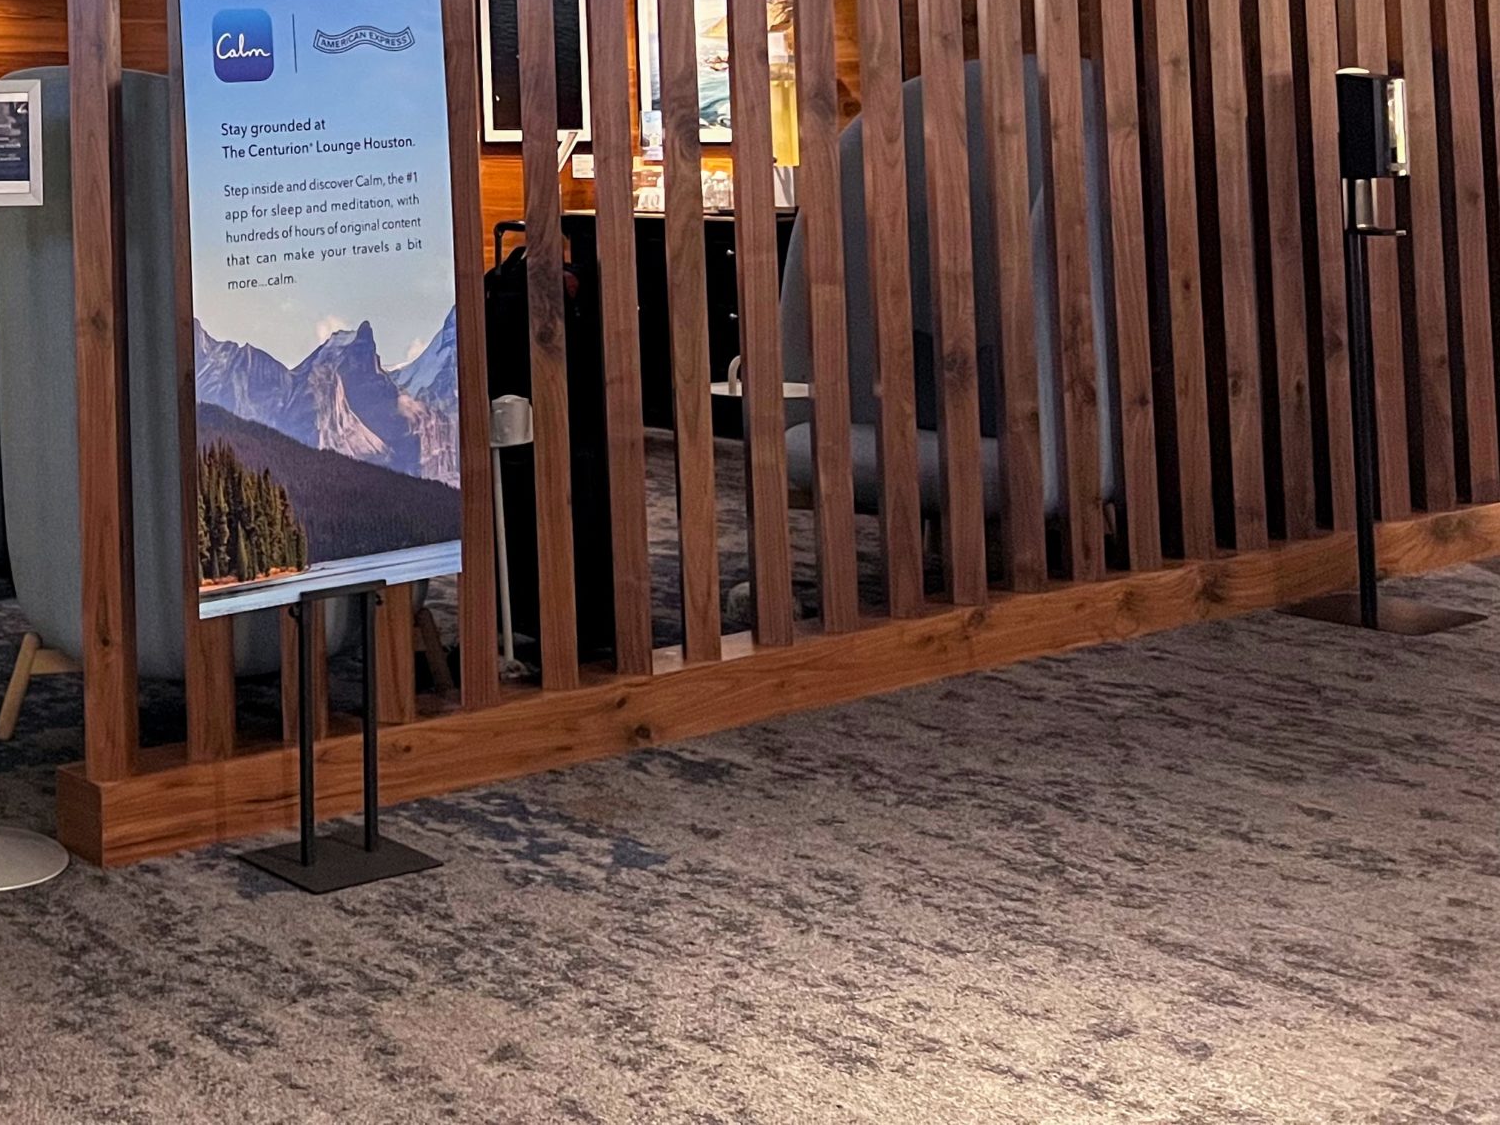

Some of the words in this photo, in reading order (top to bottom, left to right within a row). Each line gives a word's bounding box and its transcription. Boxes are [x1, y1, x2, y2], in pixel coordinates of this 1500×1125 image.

[216, 33, 270, 60] Calm
[320, 31, 367, 48] AMERICAN
[369, 32, 408, 48] EXPRESS
[222, 123, 247, 138] Stay
[251, 118, 311, 137] grounded
[314, 120, 325, 130] at
[222, 146, 245, 159] The
[316, 140, 361, 154] Lounge
[364, 137, 416, 149] Houston.
[224, 184, 249, 199] Step
[252, 182, 284, 195] inside
[286, 180, 306, 192] and
[309, 178, 353, 190] discover
[356, 175, 385, 187] Calm,
[388, 173, 403, 184] the
[407, 172, 417, 183] #1
[225, 209, 248, 222] app
[252, 206, 267, 218] for
[272, 204, 302, 217] sleep
[306, 201, 327, 213] and
[331, 198, 393, 211] meditation,
[397, 194, 419, 205] with
[226, 229, 279, 243] hundreds
[282, 226, 293, 238] of
[295, 226, 325, 237] hours
[328, 222, 338, 234] of
[340, 219, 379, 235] original
[382, 217, 421, 230] content
[227, 255, 250, 266] that
[256, 253, 277, 263] can
[284, 248, 314, 261] make
[321, 247, 346, 261] your
[352, 242, 389, 255] travels
[407, 239, 422, 250] bit
